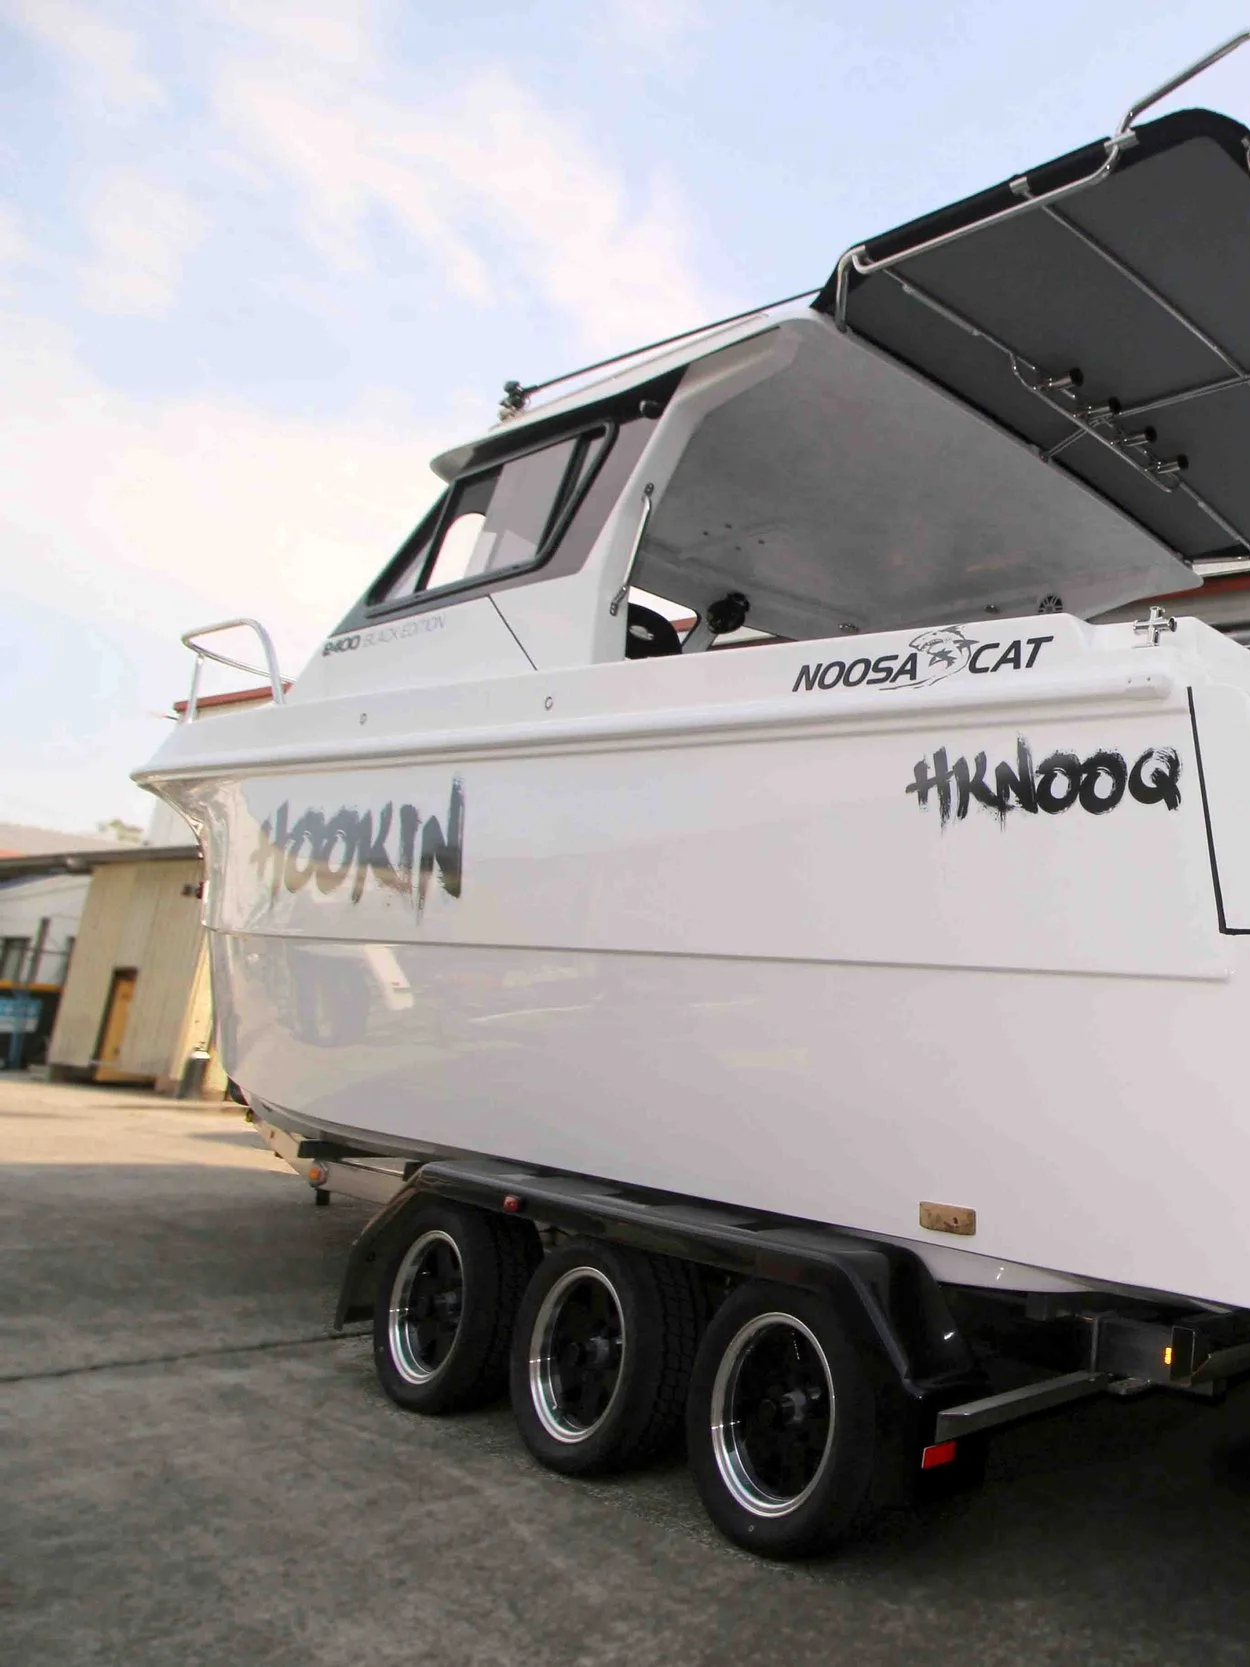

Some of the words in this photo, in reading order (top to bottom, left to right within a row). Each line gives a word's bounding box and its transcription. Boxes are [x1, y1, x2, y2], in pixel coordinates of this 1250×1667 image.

[792, 652, 918, 692] NOOSA
[968, 635, 1054, 674] CAT
[905, 731, 1183, 836] HKNOOQ
[250, 772, 465, 922] HOOKIN
